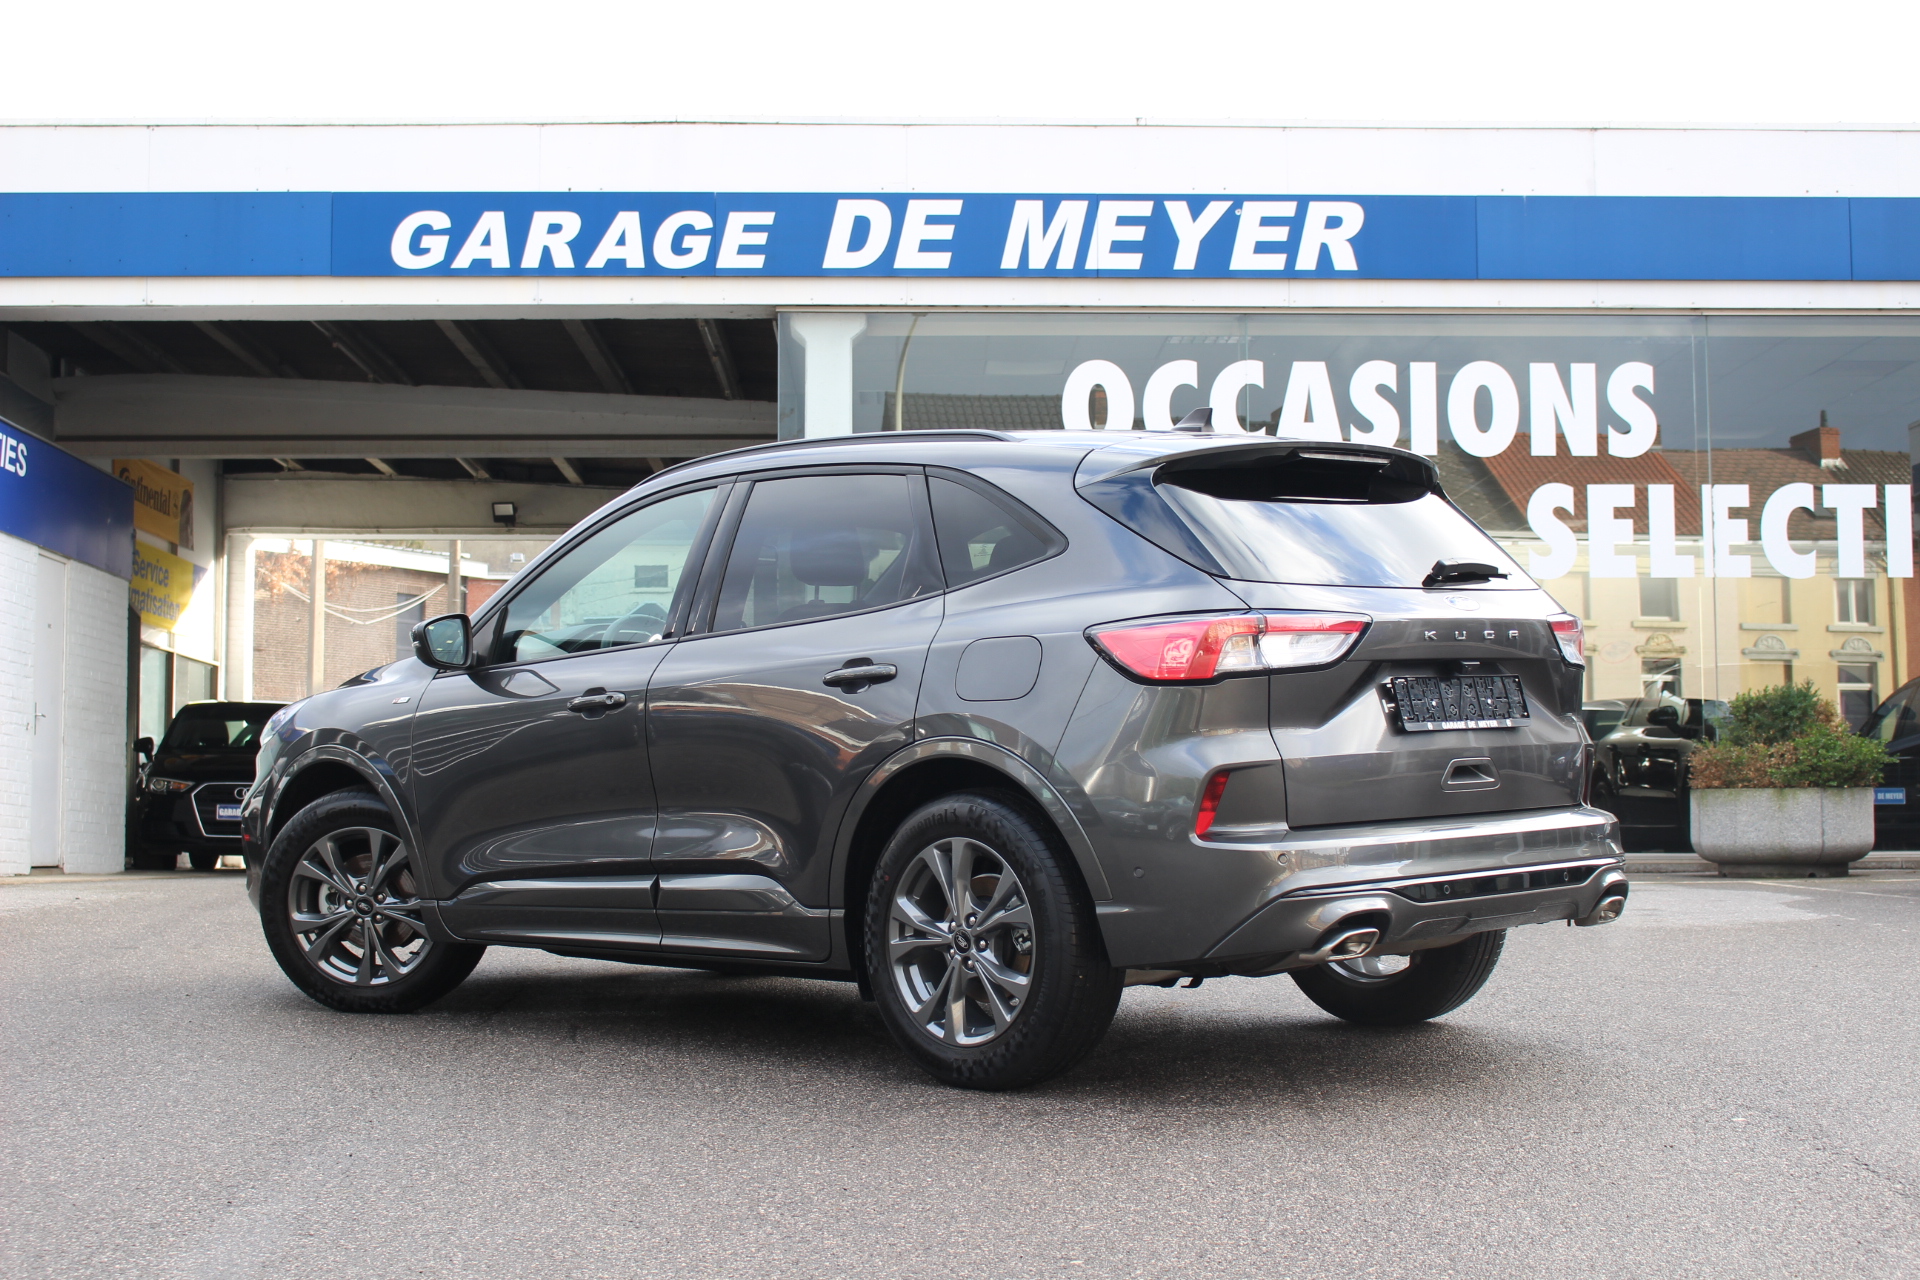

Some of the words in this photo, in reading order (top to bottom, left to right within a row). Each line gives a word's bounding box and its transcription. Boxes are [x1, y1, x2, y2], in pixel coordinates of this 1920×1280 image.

[390, 209, 776, 270] GARAGE
[822, 198, 964, 270] DE
[1000, 199, 1365, 271] MEYER
[1061, 359, 1658, 459] OCCASIONS
[1526, 482, 1914, 580] SELECTI
[132, 550, 170, 587] Service
[1424, 630, 1519, 640] KUGA
[1441, 721, 1466, 729] GARAGE
[1467, 720, 1476, 728] DE
[1477, 719, 1498, 728] MEYER
[1877, 792, 1884, 800] DE
[1885, 792, 1903, 800] MEYER
